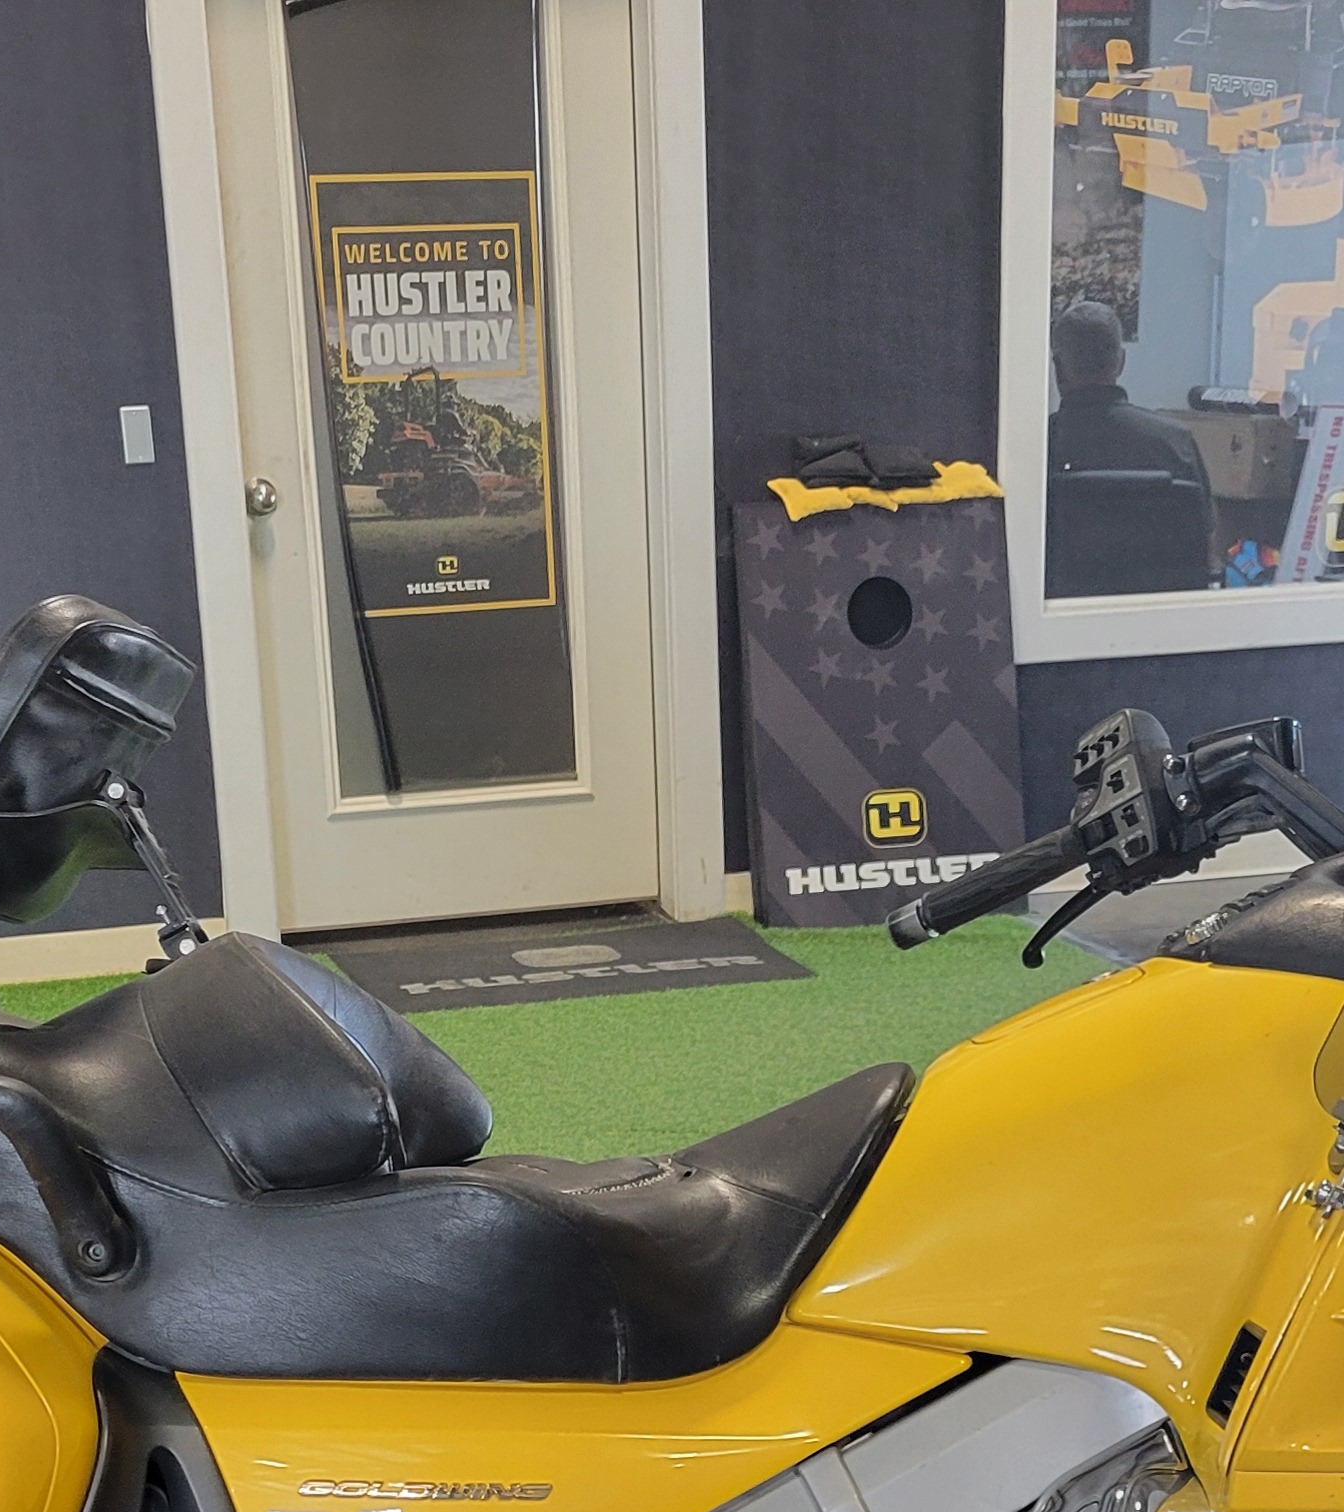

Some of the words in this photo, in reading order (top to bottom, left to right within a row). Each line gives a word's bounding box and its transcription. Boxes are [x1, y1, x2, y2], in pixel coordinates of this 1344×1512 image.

[1207, 73, 1279, 99] RAPTOR
[1101, 112, 1179, 135] HUSTLER
[344, 241, 469, 264] WELCOME
[479, 240, 510, 261] TO
[346, 269, 513, 317] HUSTLER
[351, 319, 513, 367] COUNTRY
[1329, 415, 1344, 438] NO
[1300, 445, 1337, 552] TRESPASSING
[407, 579, 491, 595] HUSTLER
[400, 955, 765, 996] HUSTLER
[298, 1480, 553, 1501] GOLDWING
